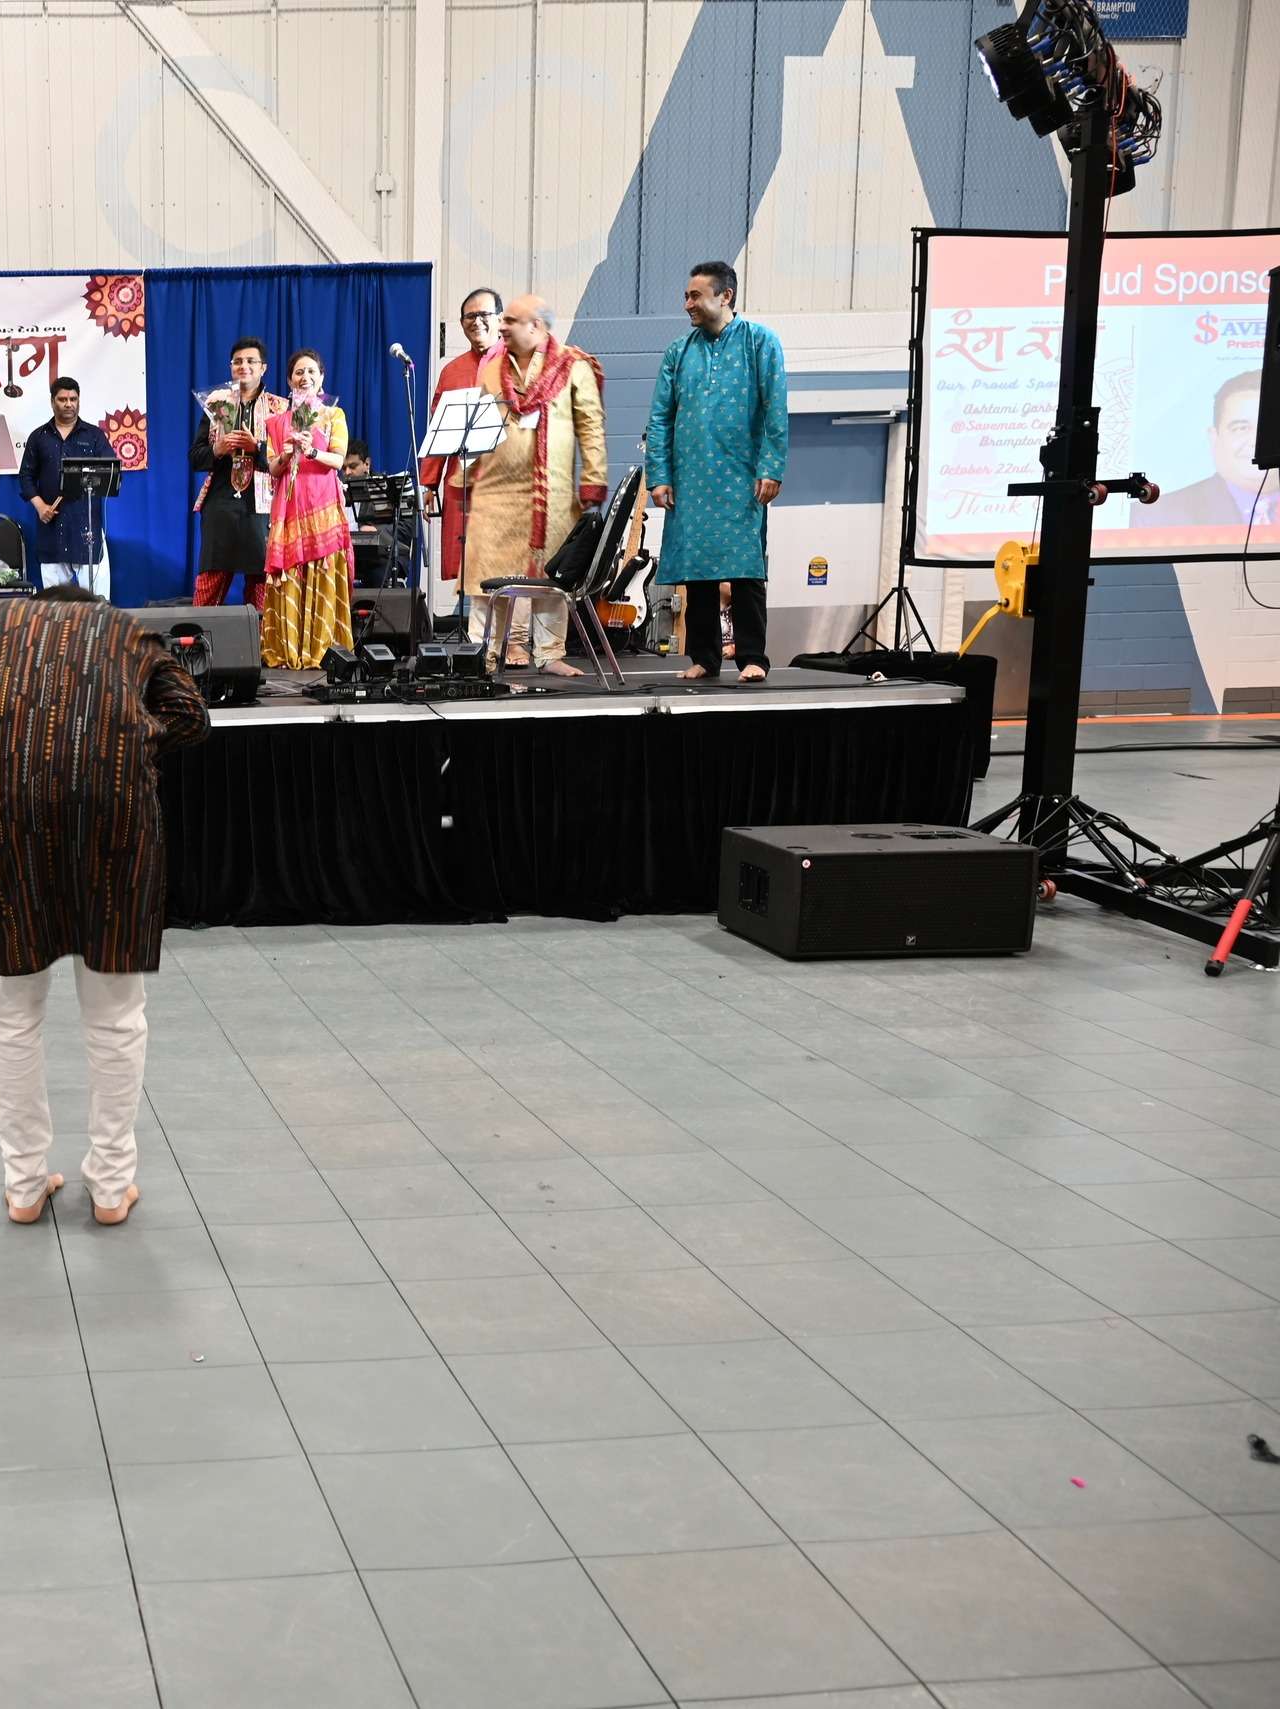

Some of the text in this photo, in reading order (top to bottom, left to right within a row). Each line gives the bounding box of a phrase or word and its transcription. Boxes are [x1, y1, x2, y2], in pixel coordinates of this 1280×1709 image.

[1096, 1, 1136, 13] BRAMPTON
[1044, 263, 1271, 303] Pud Sponso
[937, 379, 966, 392] Our
[972, 378, 1019, 391] Proud
[940, 464, 993, 476] October
[944, 488, 1023, 520] Thank
